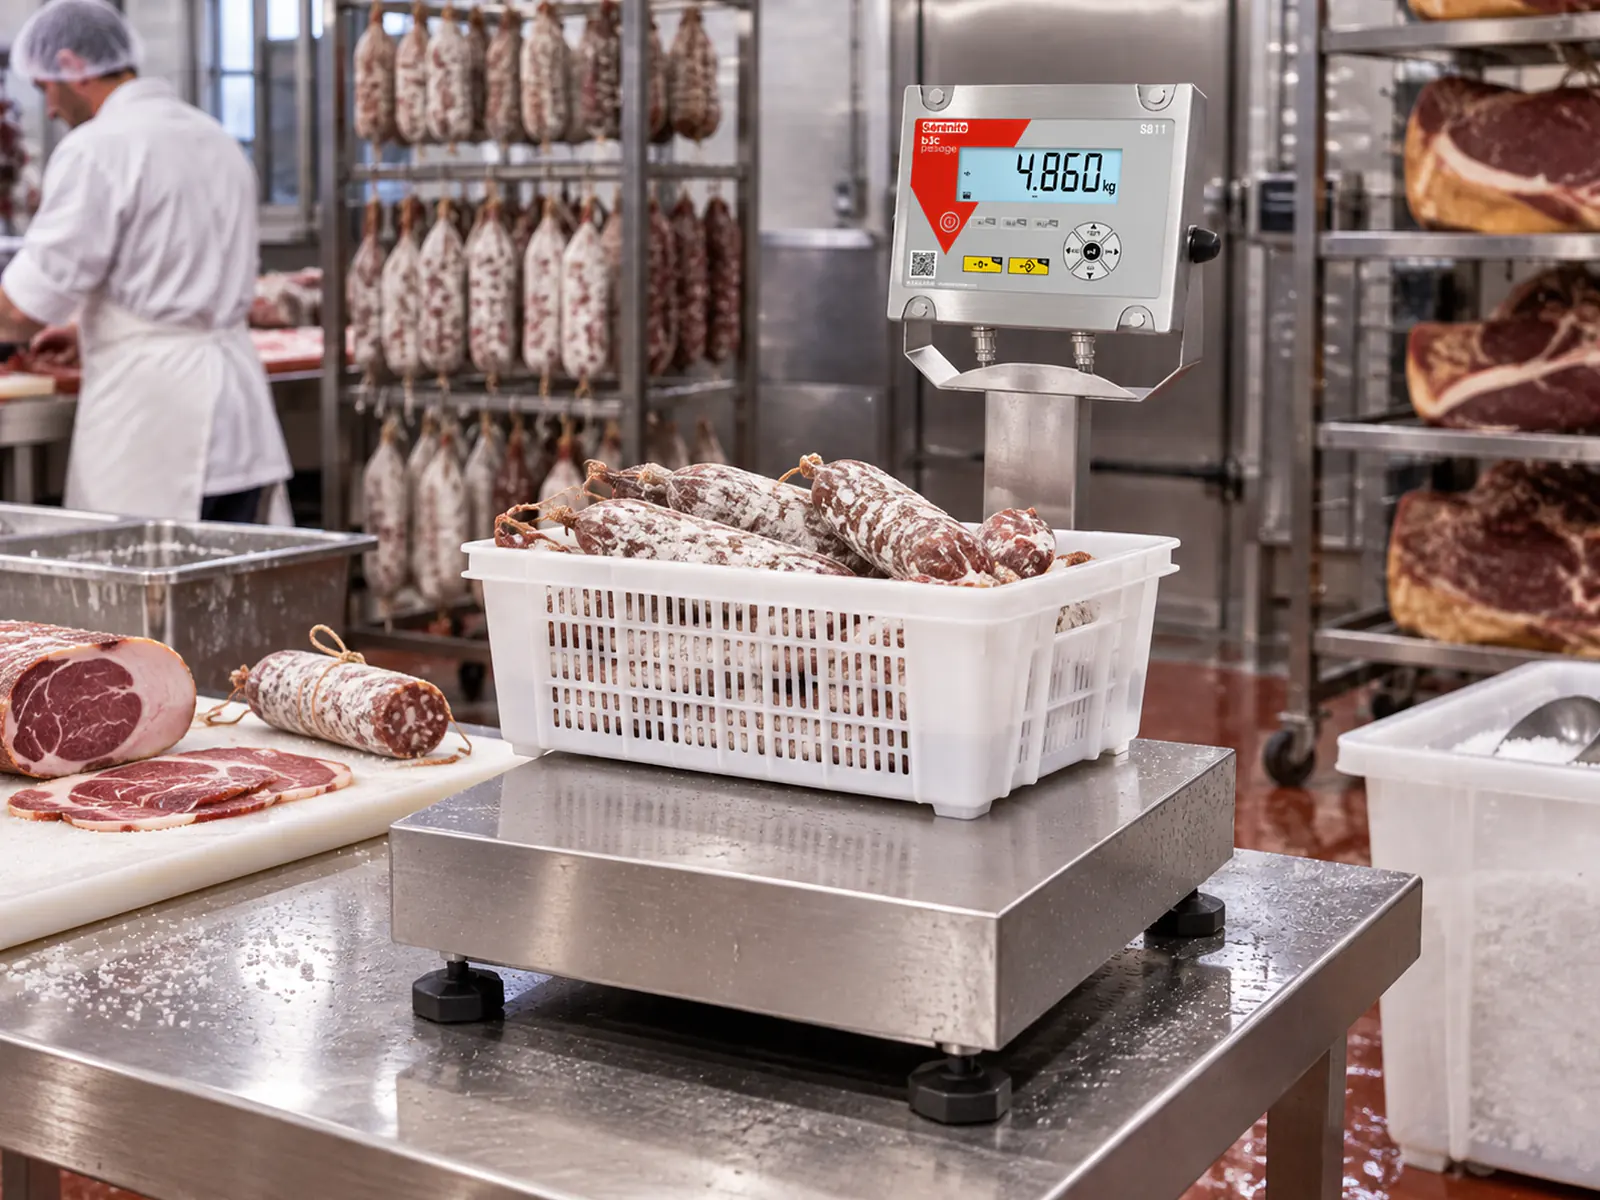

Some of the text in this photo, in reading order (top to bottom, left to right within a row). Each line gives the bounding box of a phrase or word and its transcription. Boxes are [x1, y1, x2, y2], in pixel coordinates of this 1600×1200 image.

[1140, 124, 1165, 134] S811
[1016, 152, 1116, 195] 4.860 kg
